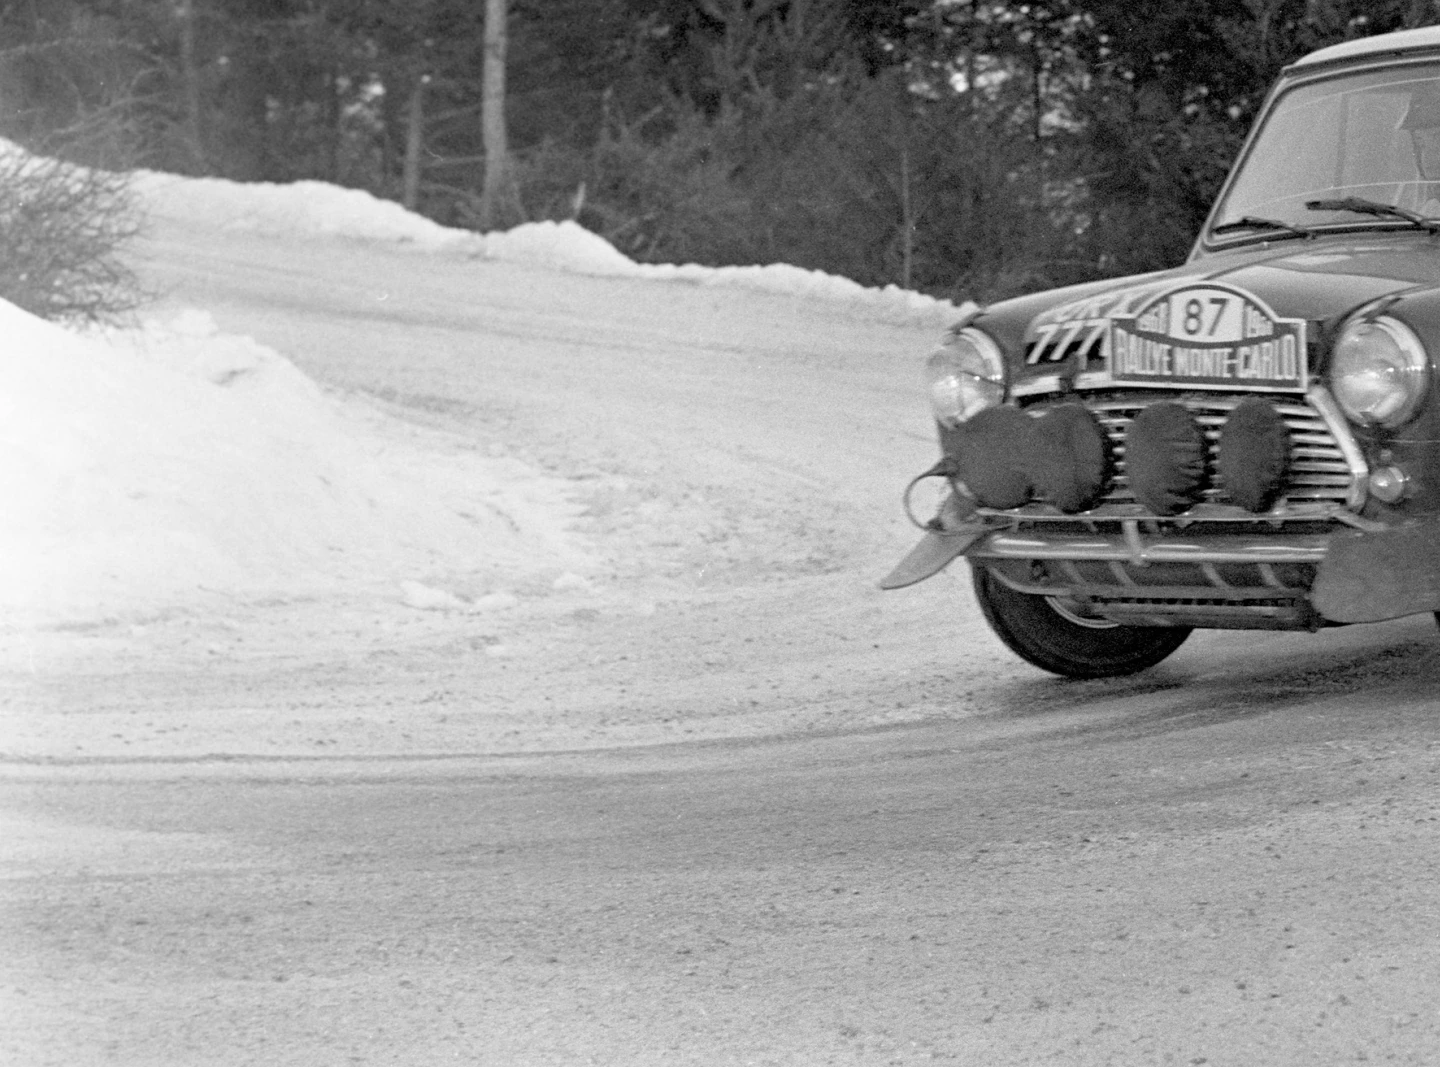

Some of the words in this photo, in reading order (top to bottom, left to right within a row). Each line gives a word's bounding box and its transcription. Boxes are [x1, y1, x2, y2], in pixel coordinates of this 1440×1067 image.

[1184, 297, 1230, 337] 87
[1026, 319, 1109, 365] 777
[1114, 328, 1173, 376] RALLYE
